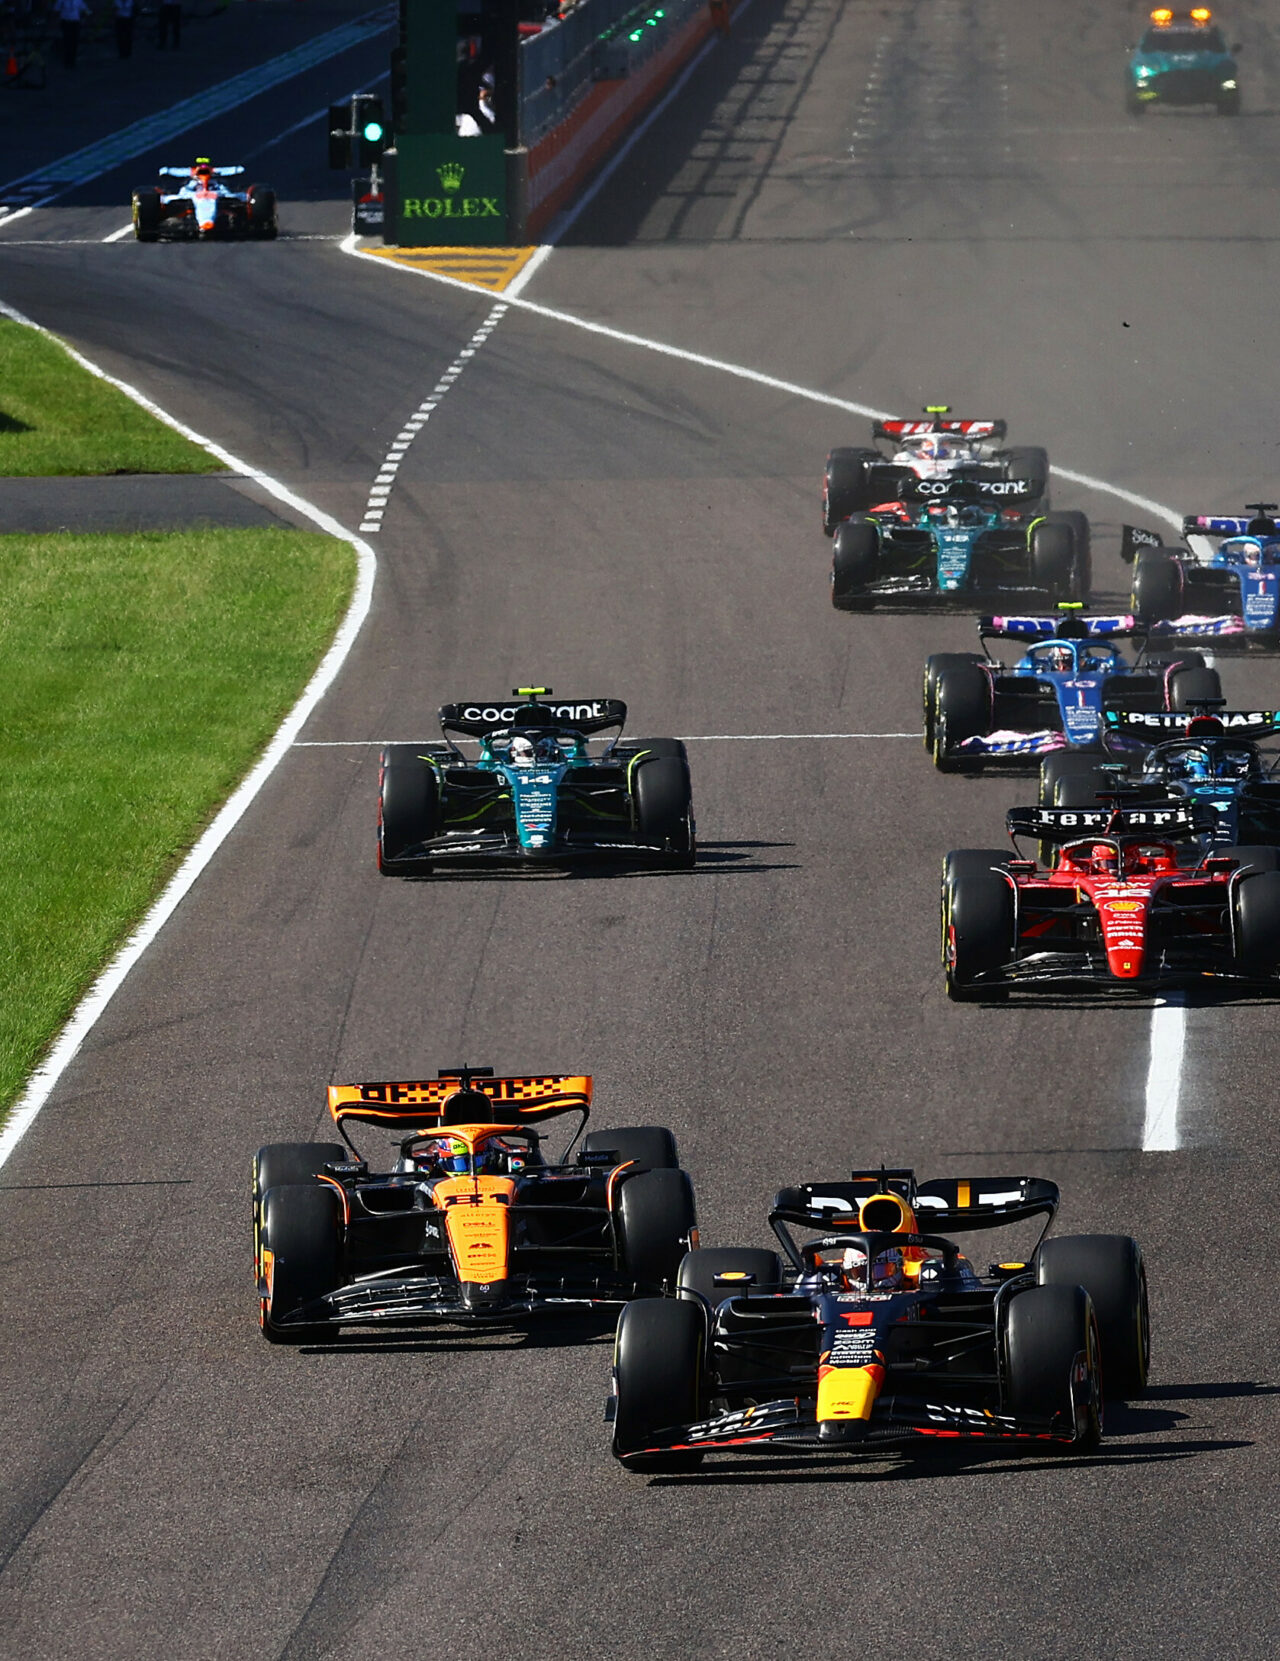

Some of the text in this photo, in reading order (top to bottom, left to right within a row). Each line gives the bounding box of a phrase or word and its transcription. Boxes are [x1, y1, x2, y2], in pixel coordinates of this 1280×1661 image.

[403, 198, 500, 218] ROLEX
[463, 702, 605, 722] coant
[1128, 712, 1264, 728] PETRNAS
[517, 775, 553, 785] 14
[1193, 786, 1235, 795] 63
[1037, 808, 1188, 826] Ferari
[840, 1311, 874, 1326] 1
